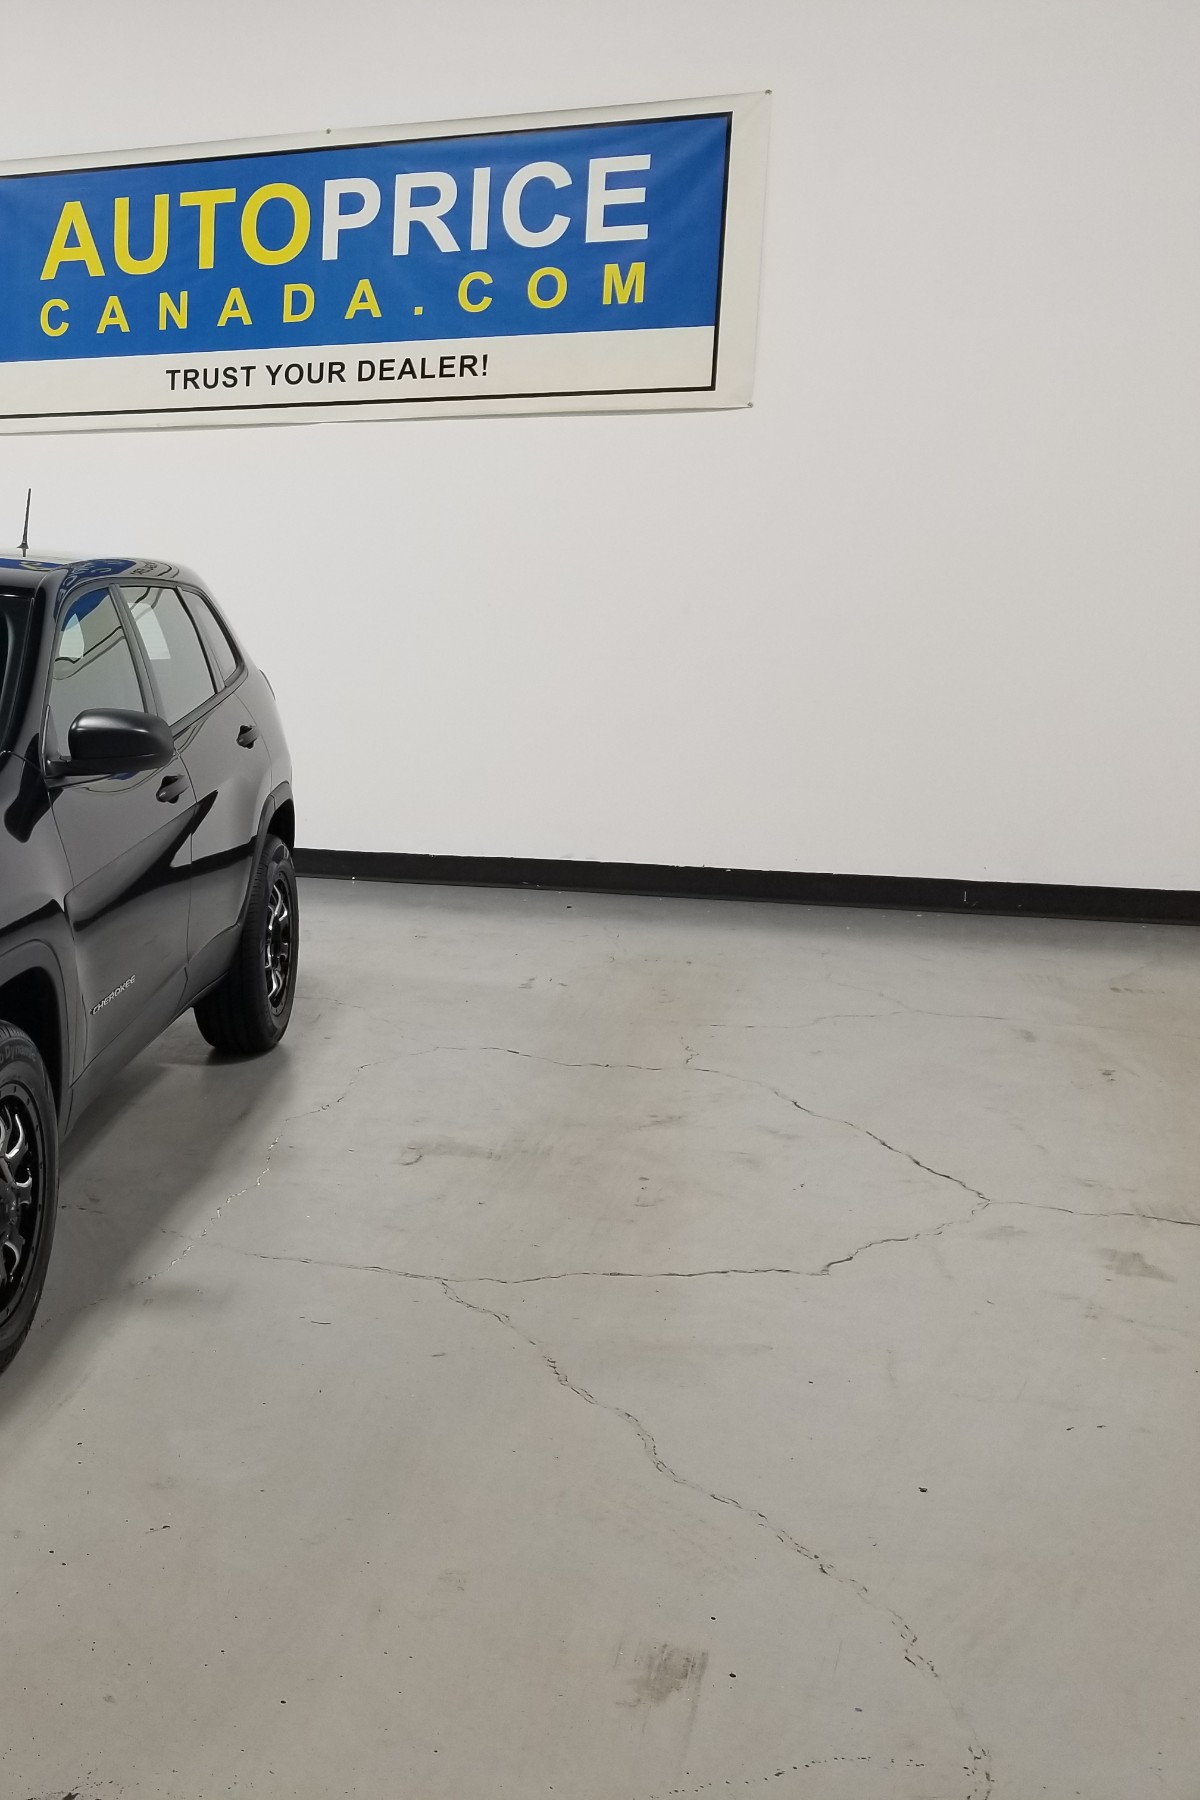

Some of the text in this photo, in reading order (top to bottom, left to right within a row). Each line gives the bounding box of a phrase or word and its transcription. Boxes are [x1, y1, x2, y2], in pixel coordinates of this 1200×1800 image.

[40, 153, 652, 280] AUTOPRICE
[165, 353, 489, 391] TRUST YOUR DEALER!
[91, 974, 136, 1015] CHEROKEE
